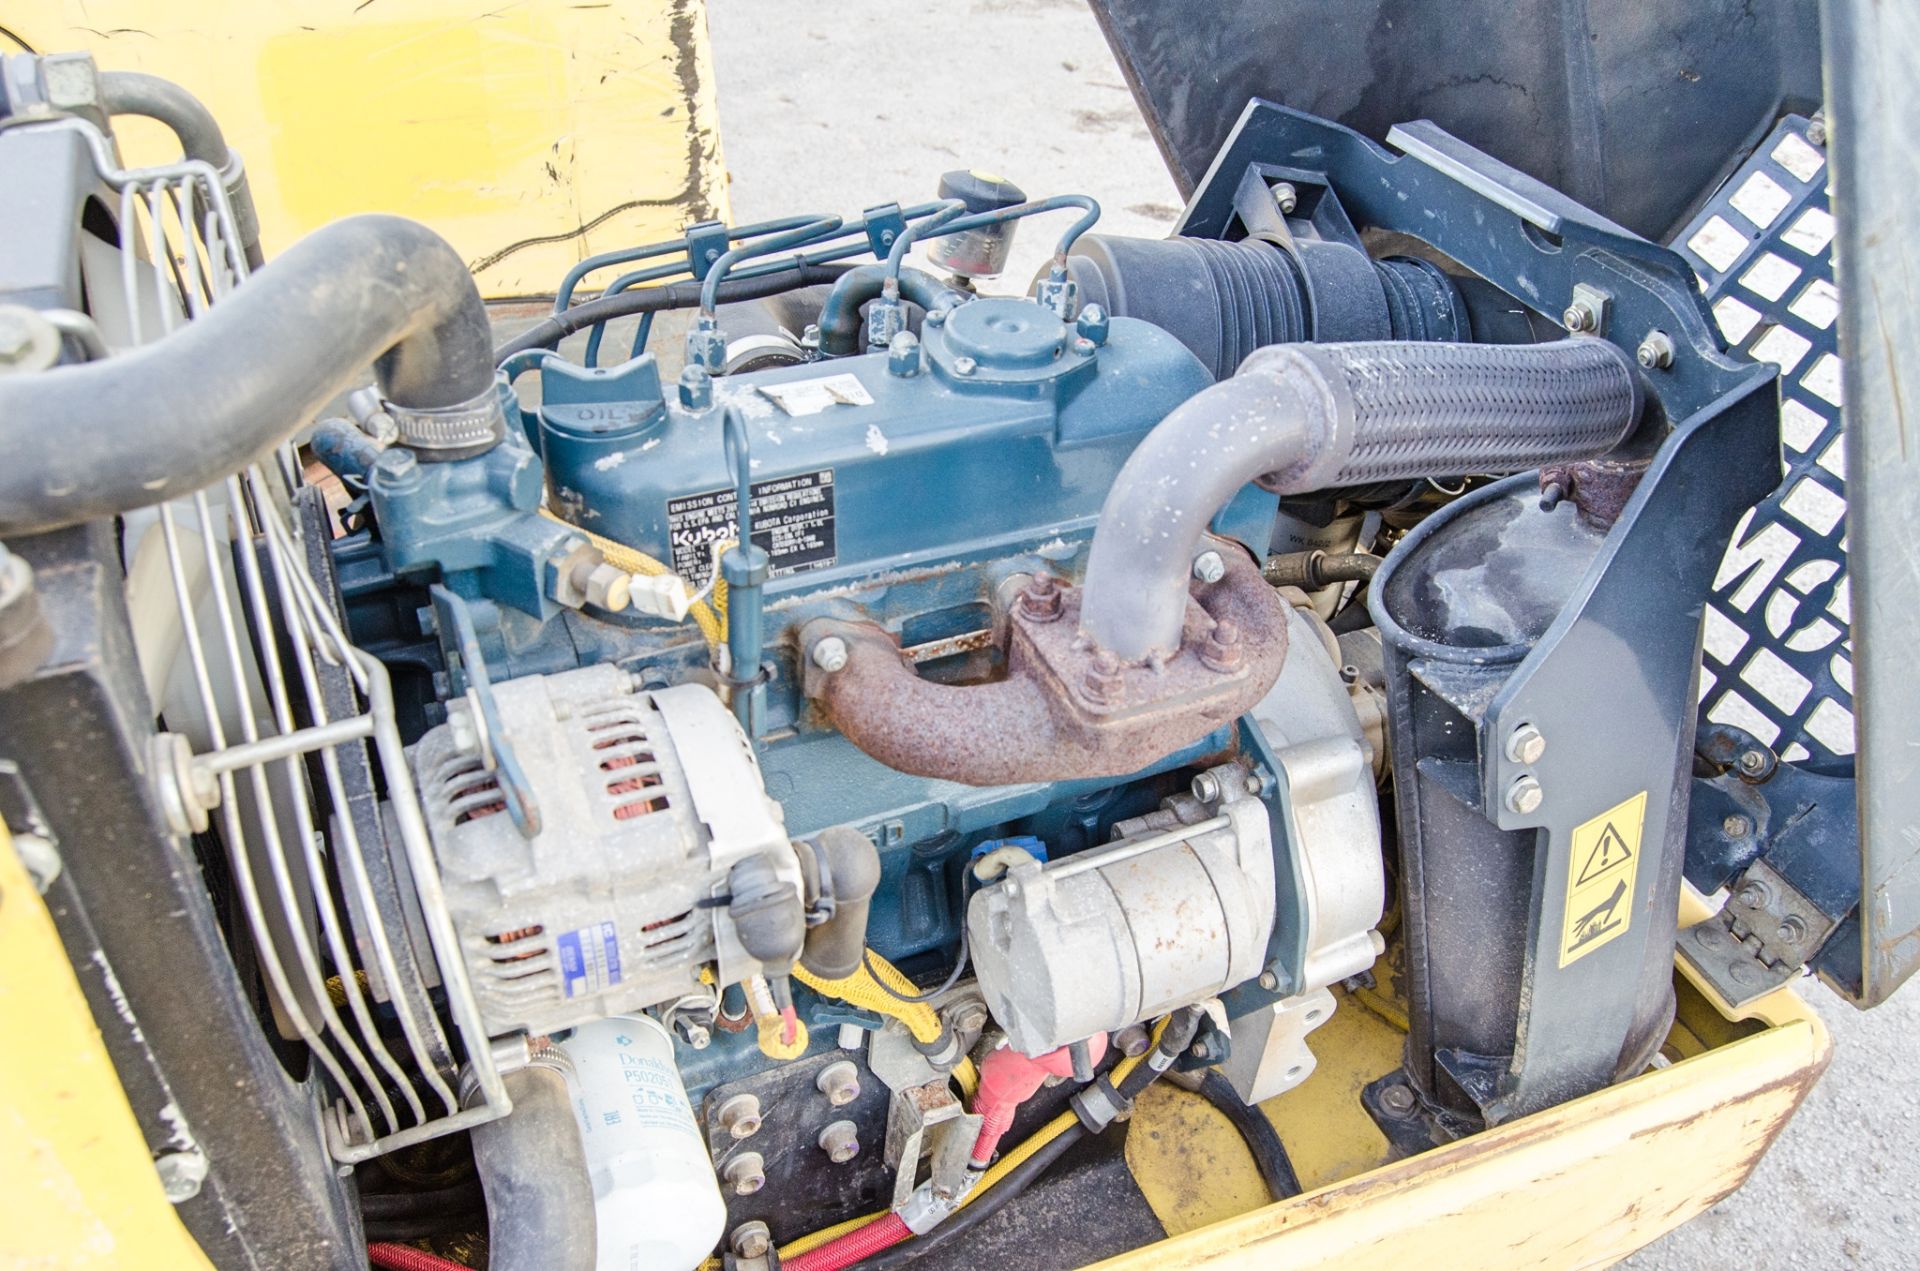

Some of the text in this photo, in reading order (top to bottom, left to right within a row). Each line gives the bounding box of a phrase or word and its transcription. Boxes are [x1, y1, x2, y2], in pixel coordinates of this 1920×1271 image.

[577, 408, 624, 421] OIL
[670, 496, 713, 512] EMISSION
[758, 477, 811, 495] INFORMATION
[754, 507, 828, 529] KUBOTA Corporation
[672, 520, 740, 548] Kubot
